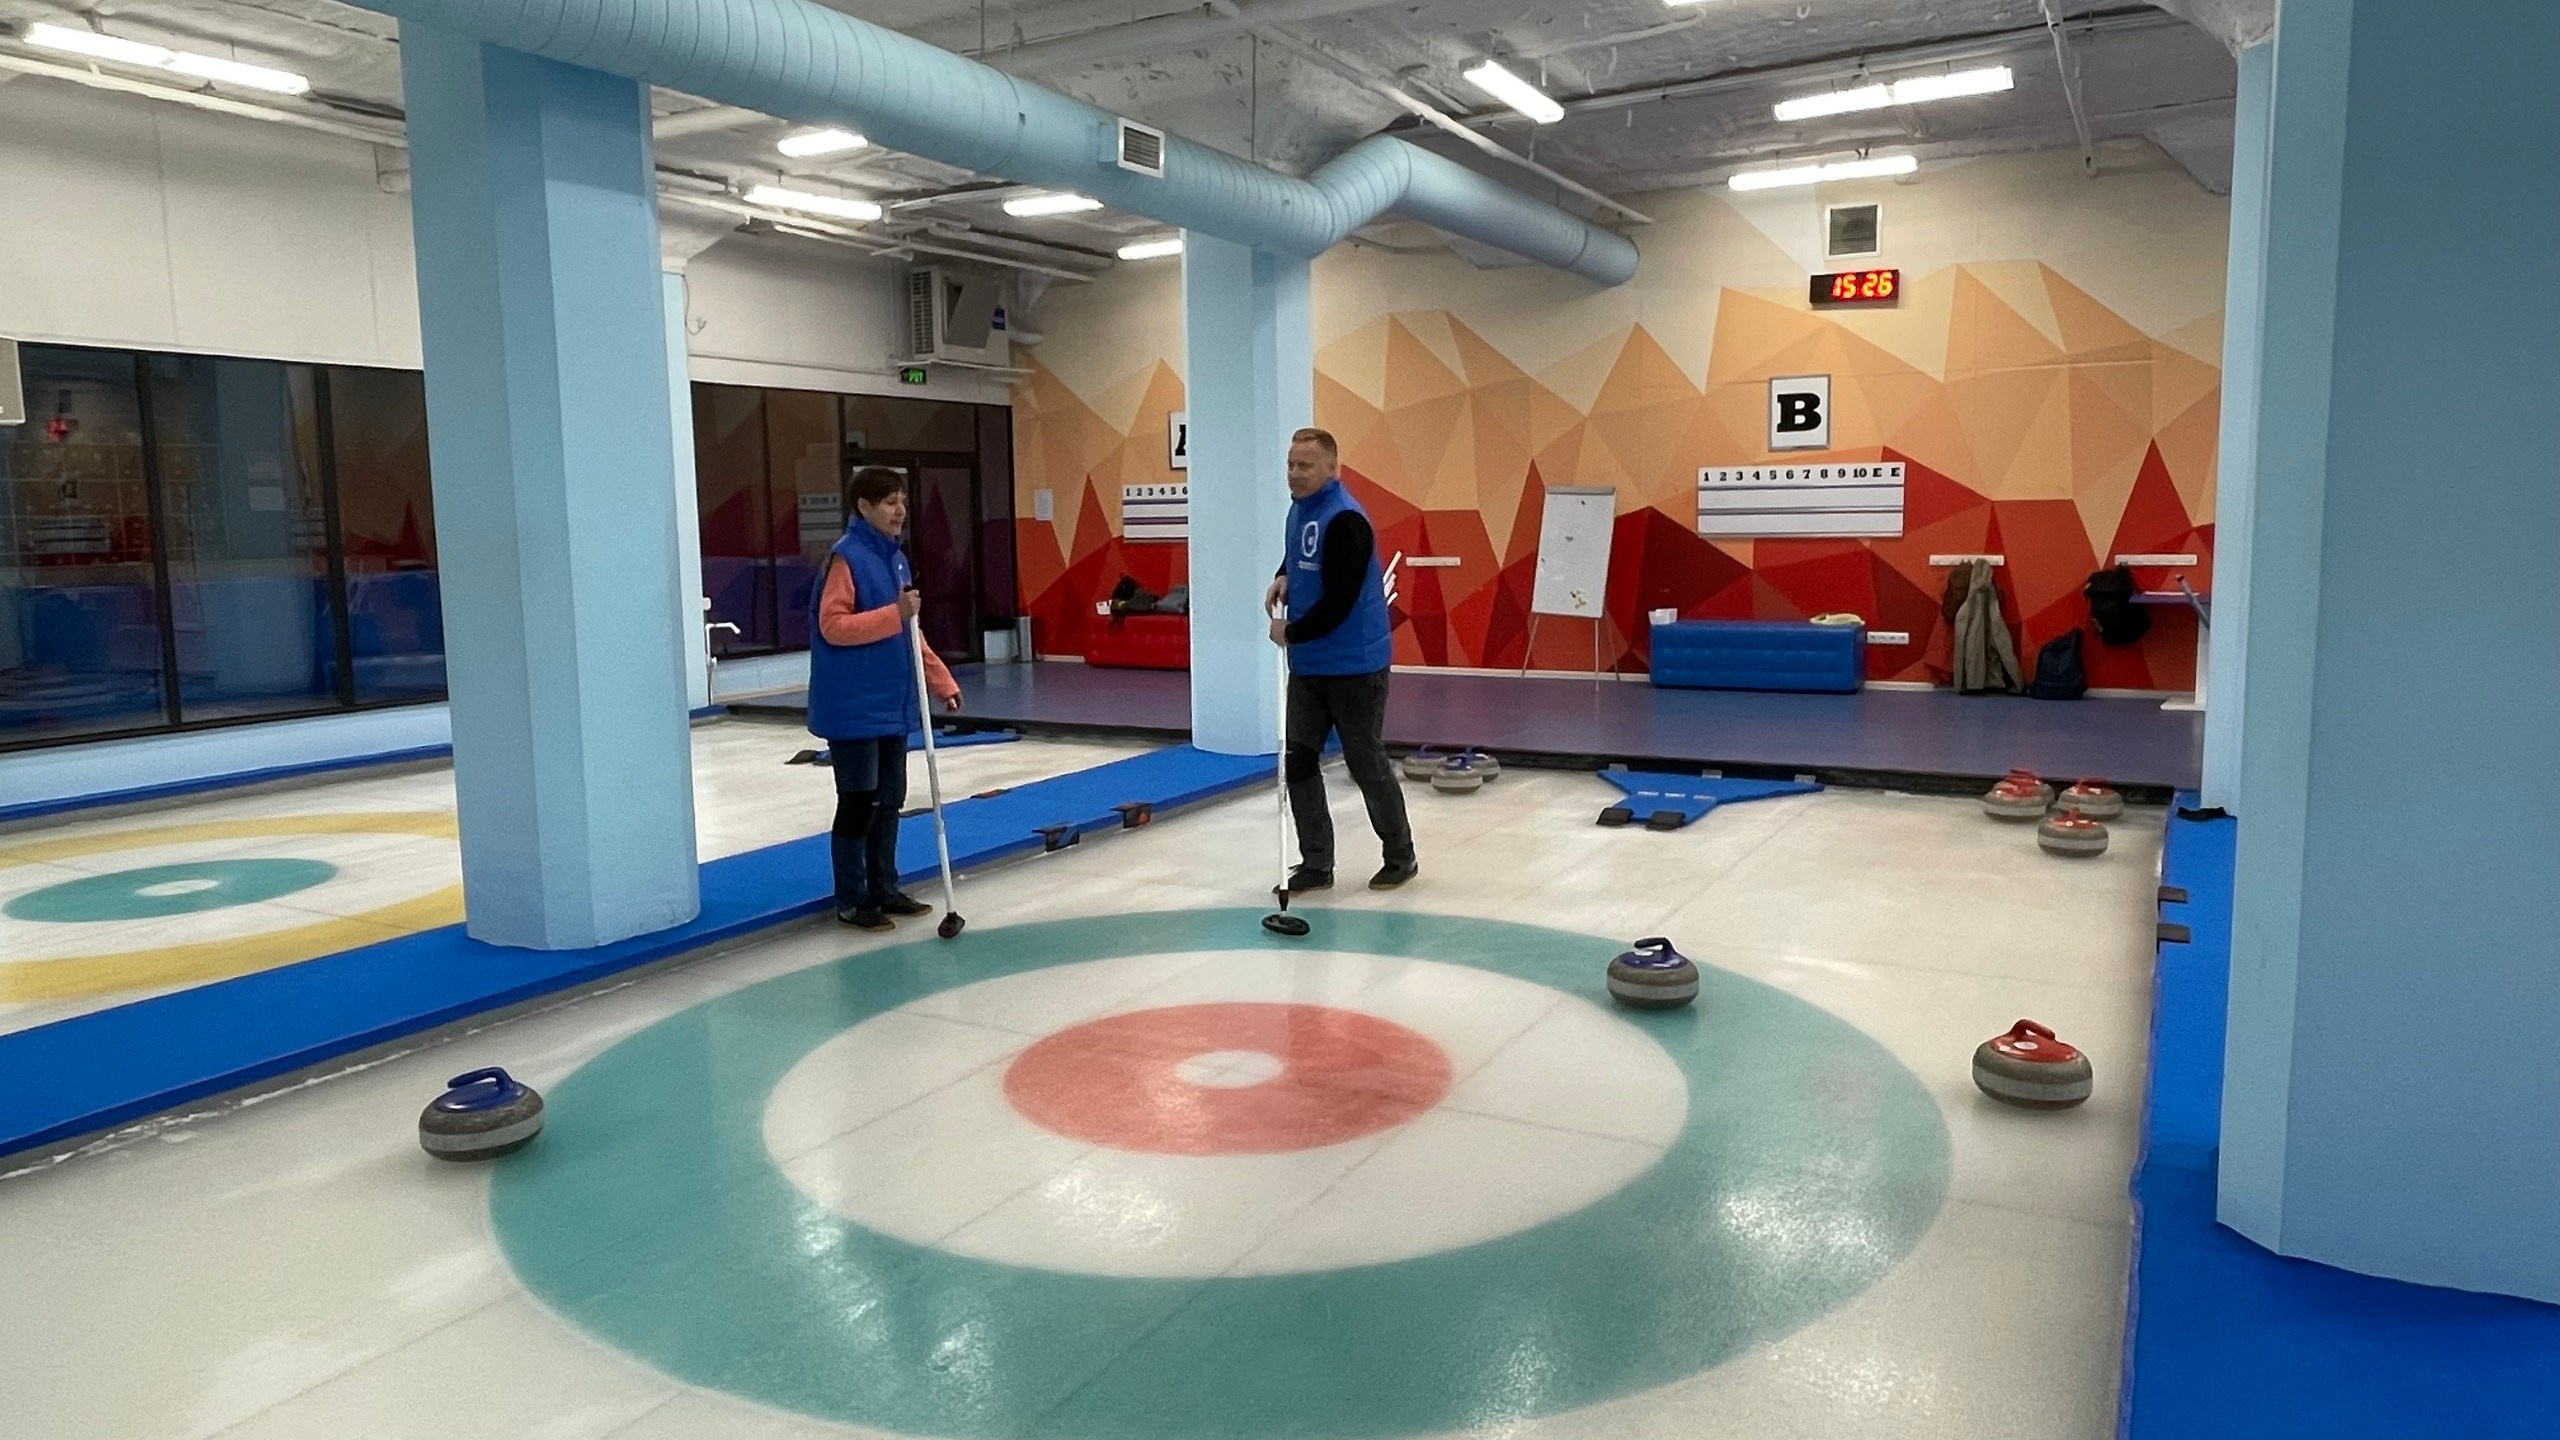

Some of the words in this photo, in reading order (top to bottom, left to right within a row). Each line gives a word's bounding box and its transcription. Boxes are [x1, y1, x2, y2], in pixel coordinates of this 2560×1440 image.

[1776, 392, 1822, 433] B
[1703, 471, 1710, 482] 1
[1719, 471, 1728, 482] 2
[1735, 471, 1744, 481] 3
[1752, 470, 1761, 481] 4
[1769, 469, 1777, 480] 5
[1785, 469, 1794, 480] 6
[1802, 468, 1811, 480] 7
[1820, 468, 1829, 479] 8
[1837, 468, 1846, 479] 9
[1852, 467, 1868, 479] 10
[1872, 467, 1882, 478] E
[1890, 466, 1900, 478] E
[1125, 487, 1131, 497] 1
[1136, 487, 1143, 497] 2
[1147, 487, 1154, 497] 3
[1158, 486, 1166, 496] 4
[1170, 486, 1177, 496] 5
